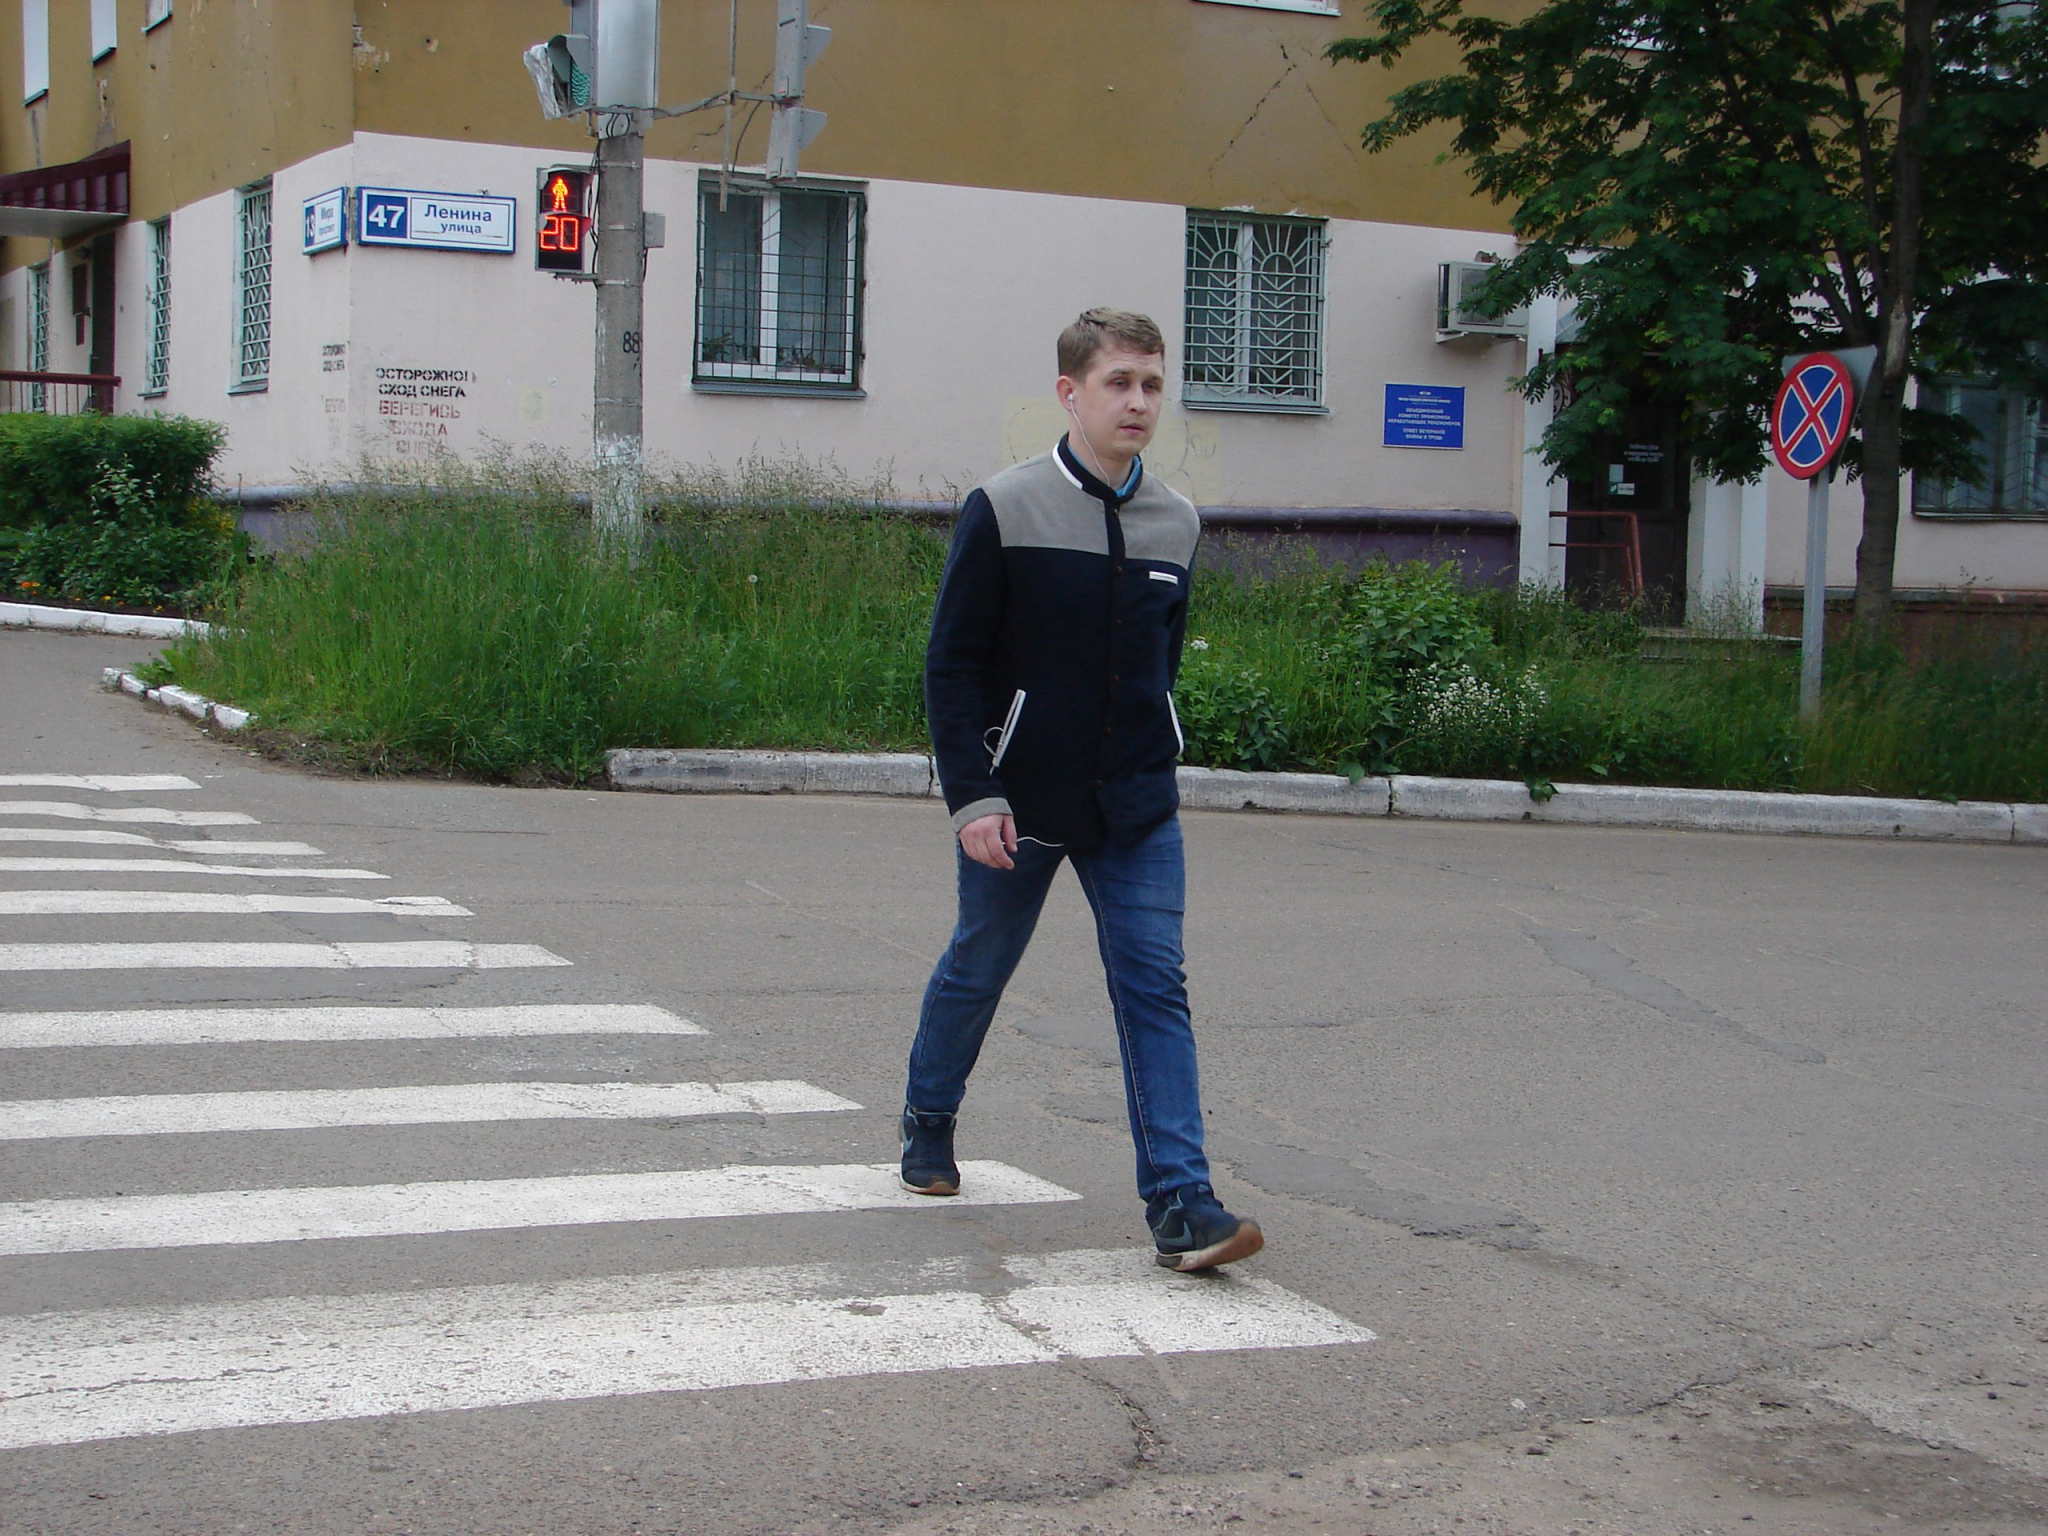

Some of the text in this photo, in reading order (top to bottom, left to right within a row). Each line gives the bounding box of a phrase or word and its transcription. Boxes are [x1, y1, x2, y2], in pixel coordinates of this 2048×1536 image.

[368, 204, 405, 229] 47
[424, 204, 492, 222] Ленина
[440, 222, 482, 235] улица
[540, 216, 579, 250] 20
[375, 367, 468, 381] ОСТОРОЖНО!
[378, 383, 466, 398] СХОД СНЕГА
[379, 400, 461, 419] БЕРЕГИСЬ
